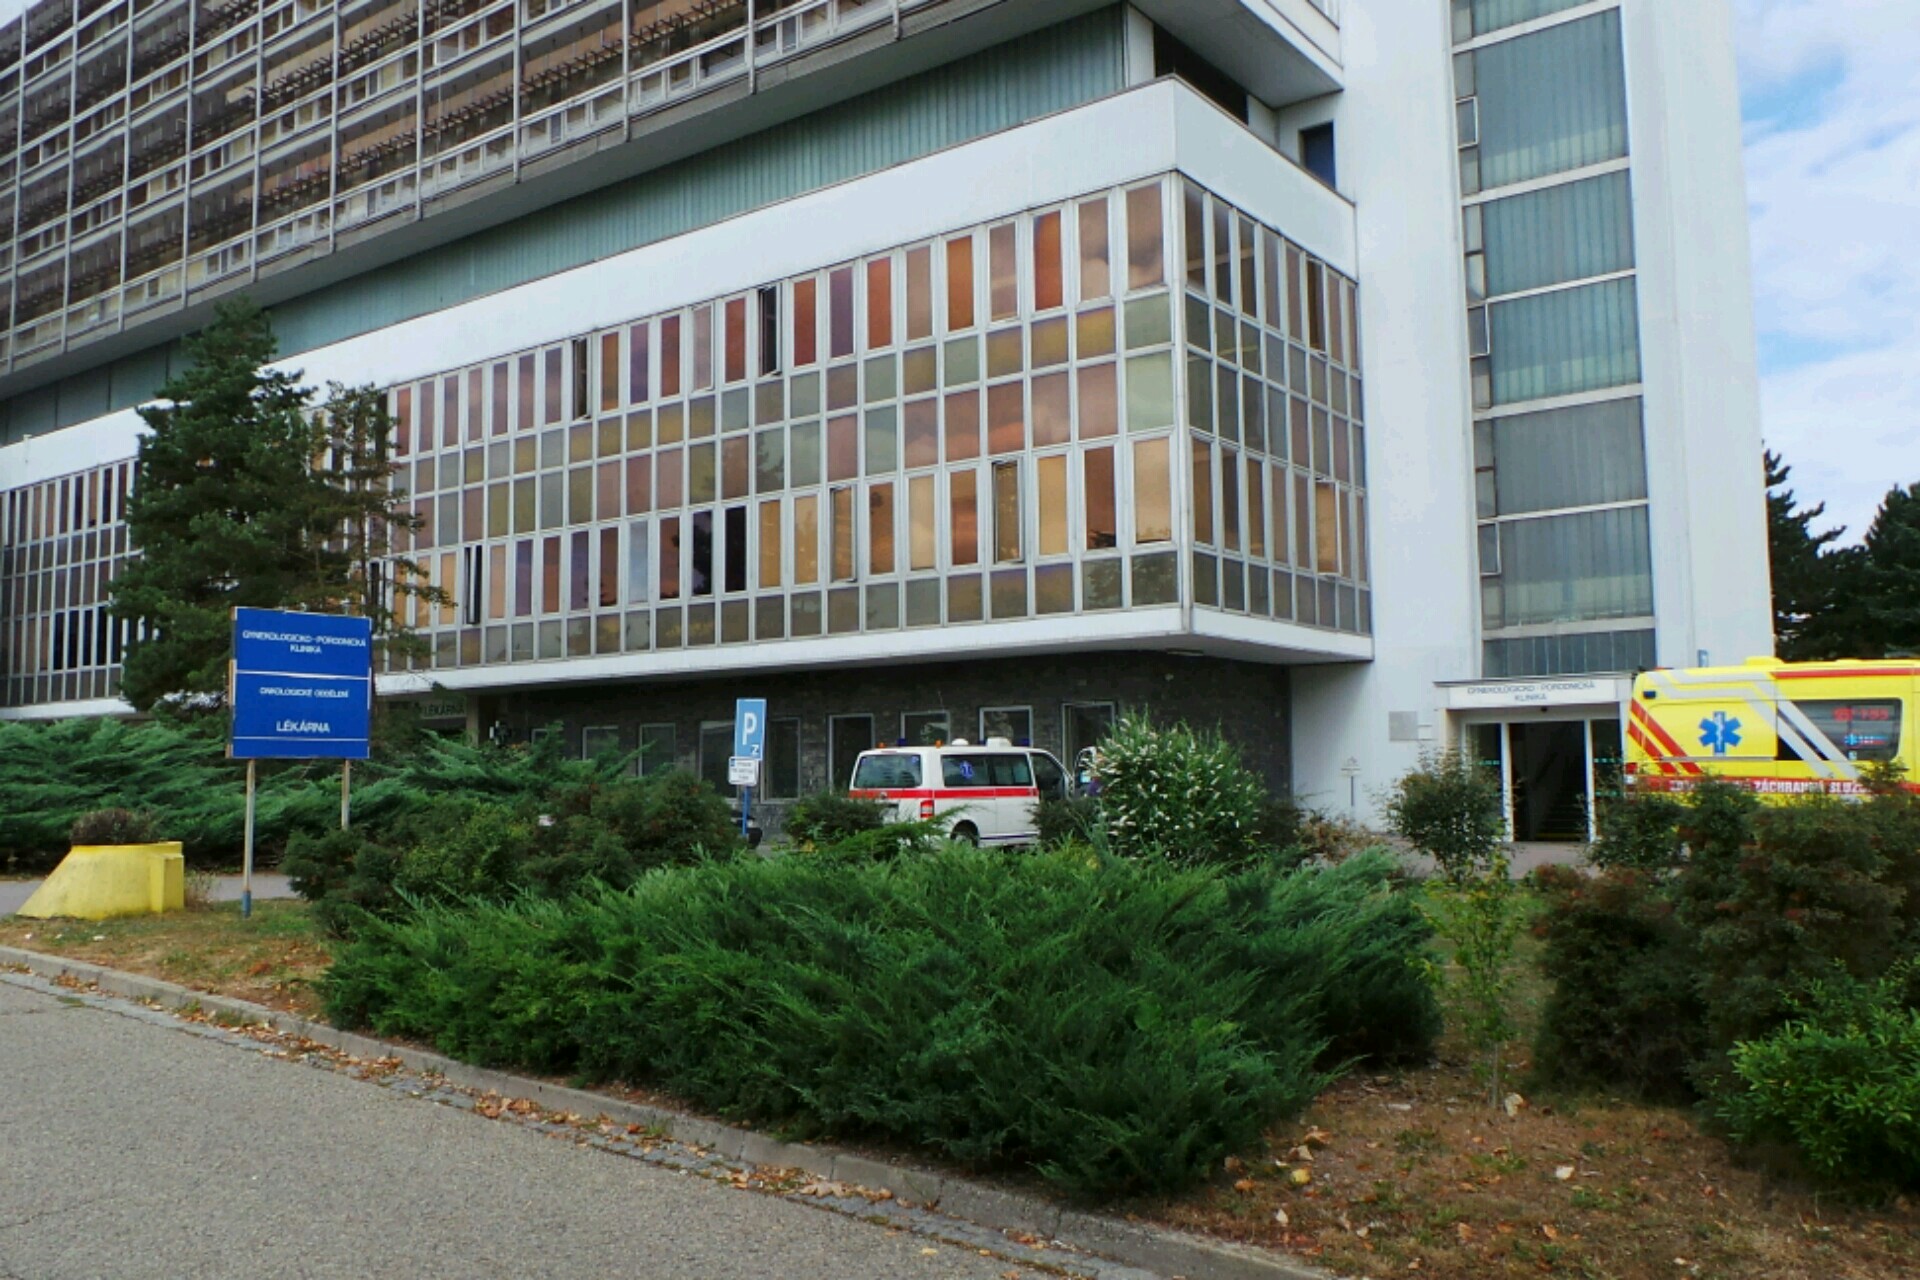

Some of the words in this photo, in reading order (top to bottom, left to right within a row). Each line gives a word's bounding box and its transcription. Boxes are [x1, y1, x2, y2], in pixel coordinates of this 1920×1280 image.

[290, 643, 322, 653] KLINIKA
[276, 718, 330, 733] LÉKÁRNA
[742, 712, 757, 745] P
